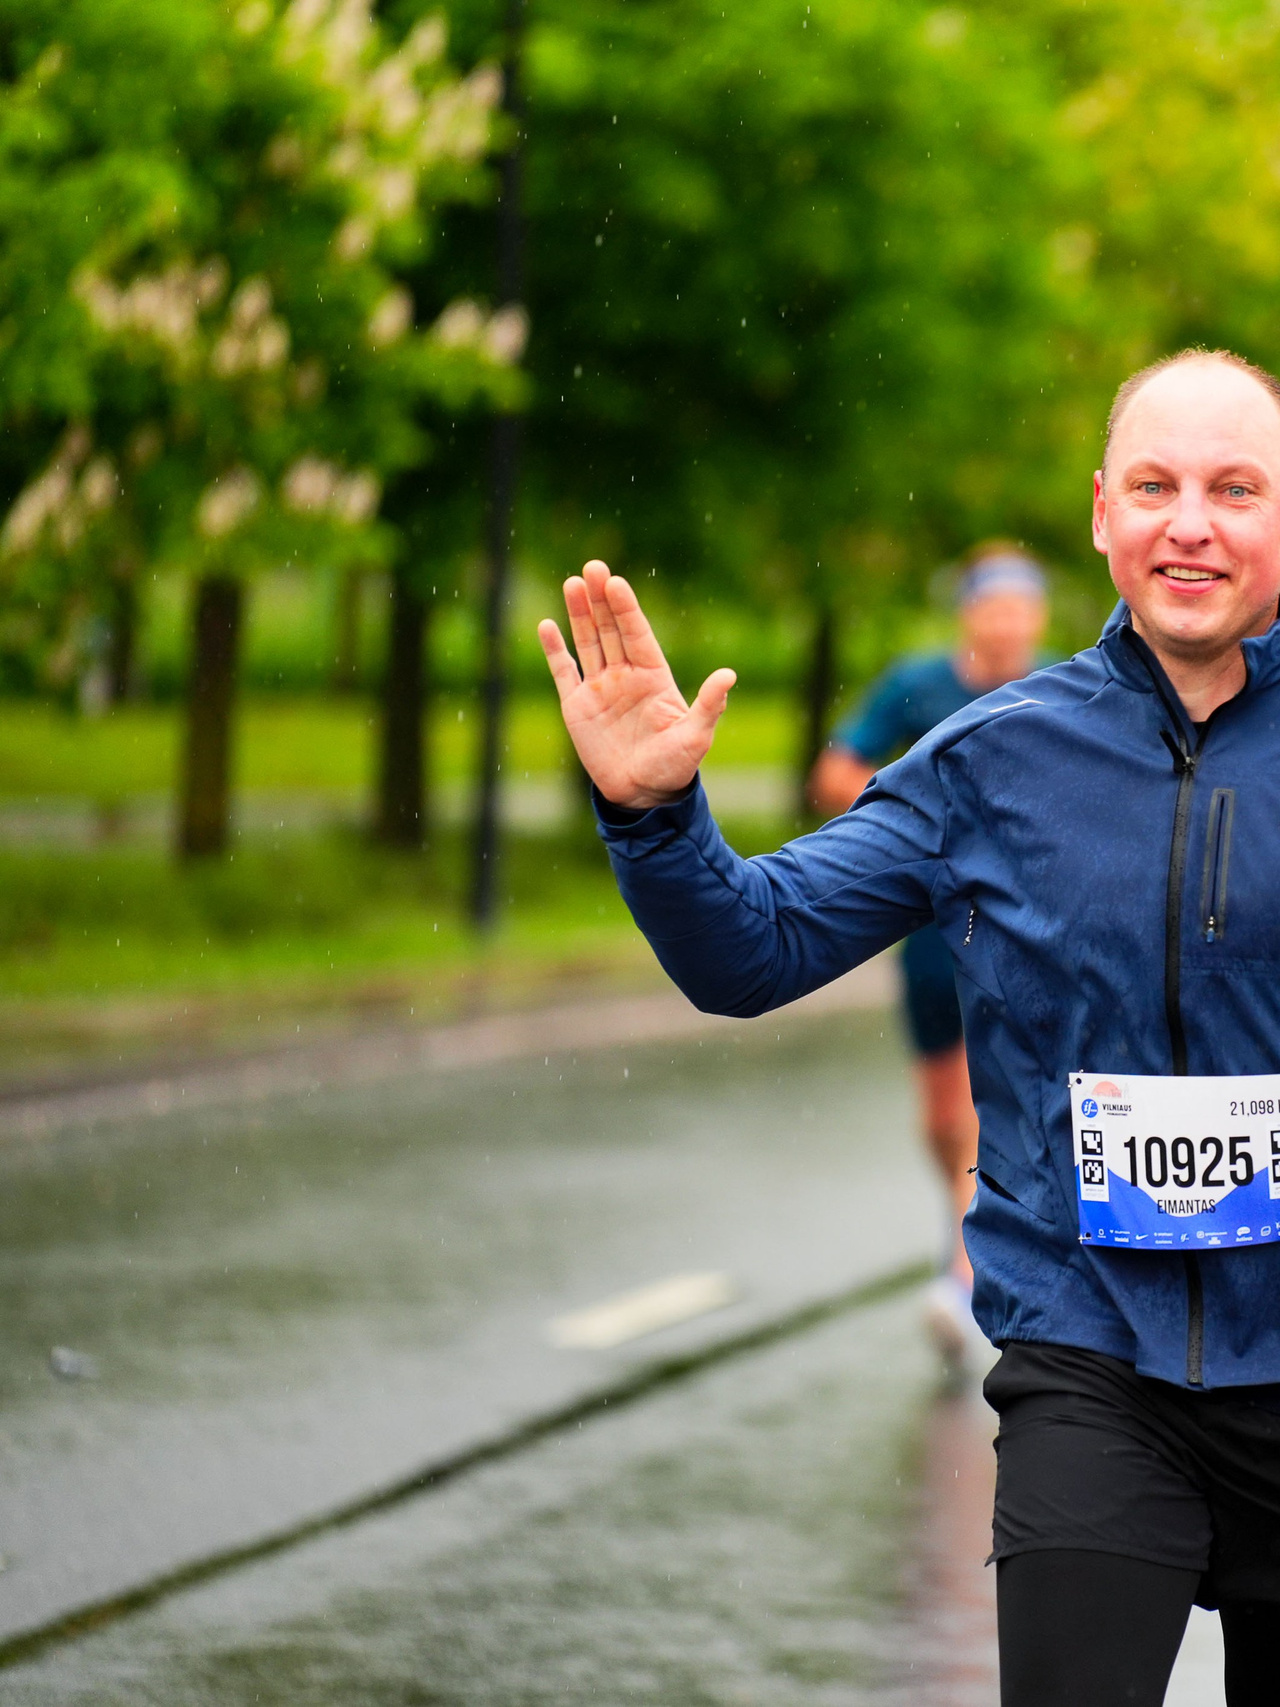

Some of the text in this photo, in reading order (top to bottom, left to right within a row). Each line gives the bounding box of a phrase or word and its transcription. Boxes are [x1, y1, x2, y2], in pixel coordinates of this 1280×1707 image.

[1102, 1104, 1132, 1112] VILNIAUS
[1230, 1099, 1275, 1117] 21,098
[1123, 1136, 1255, 1188] 10925
[1157, 1199, 1217, 1214] EIMANTAS
